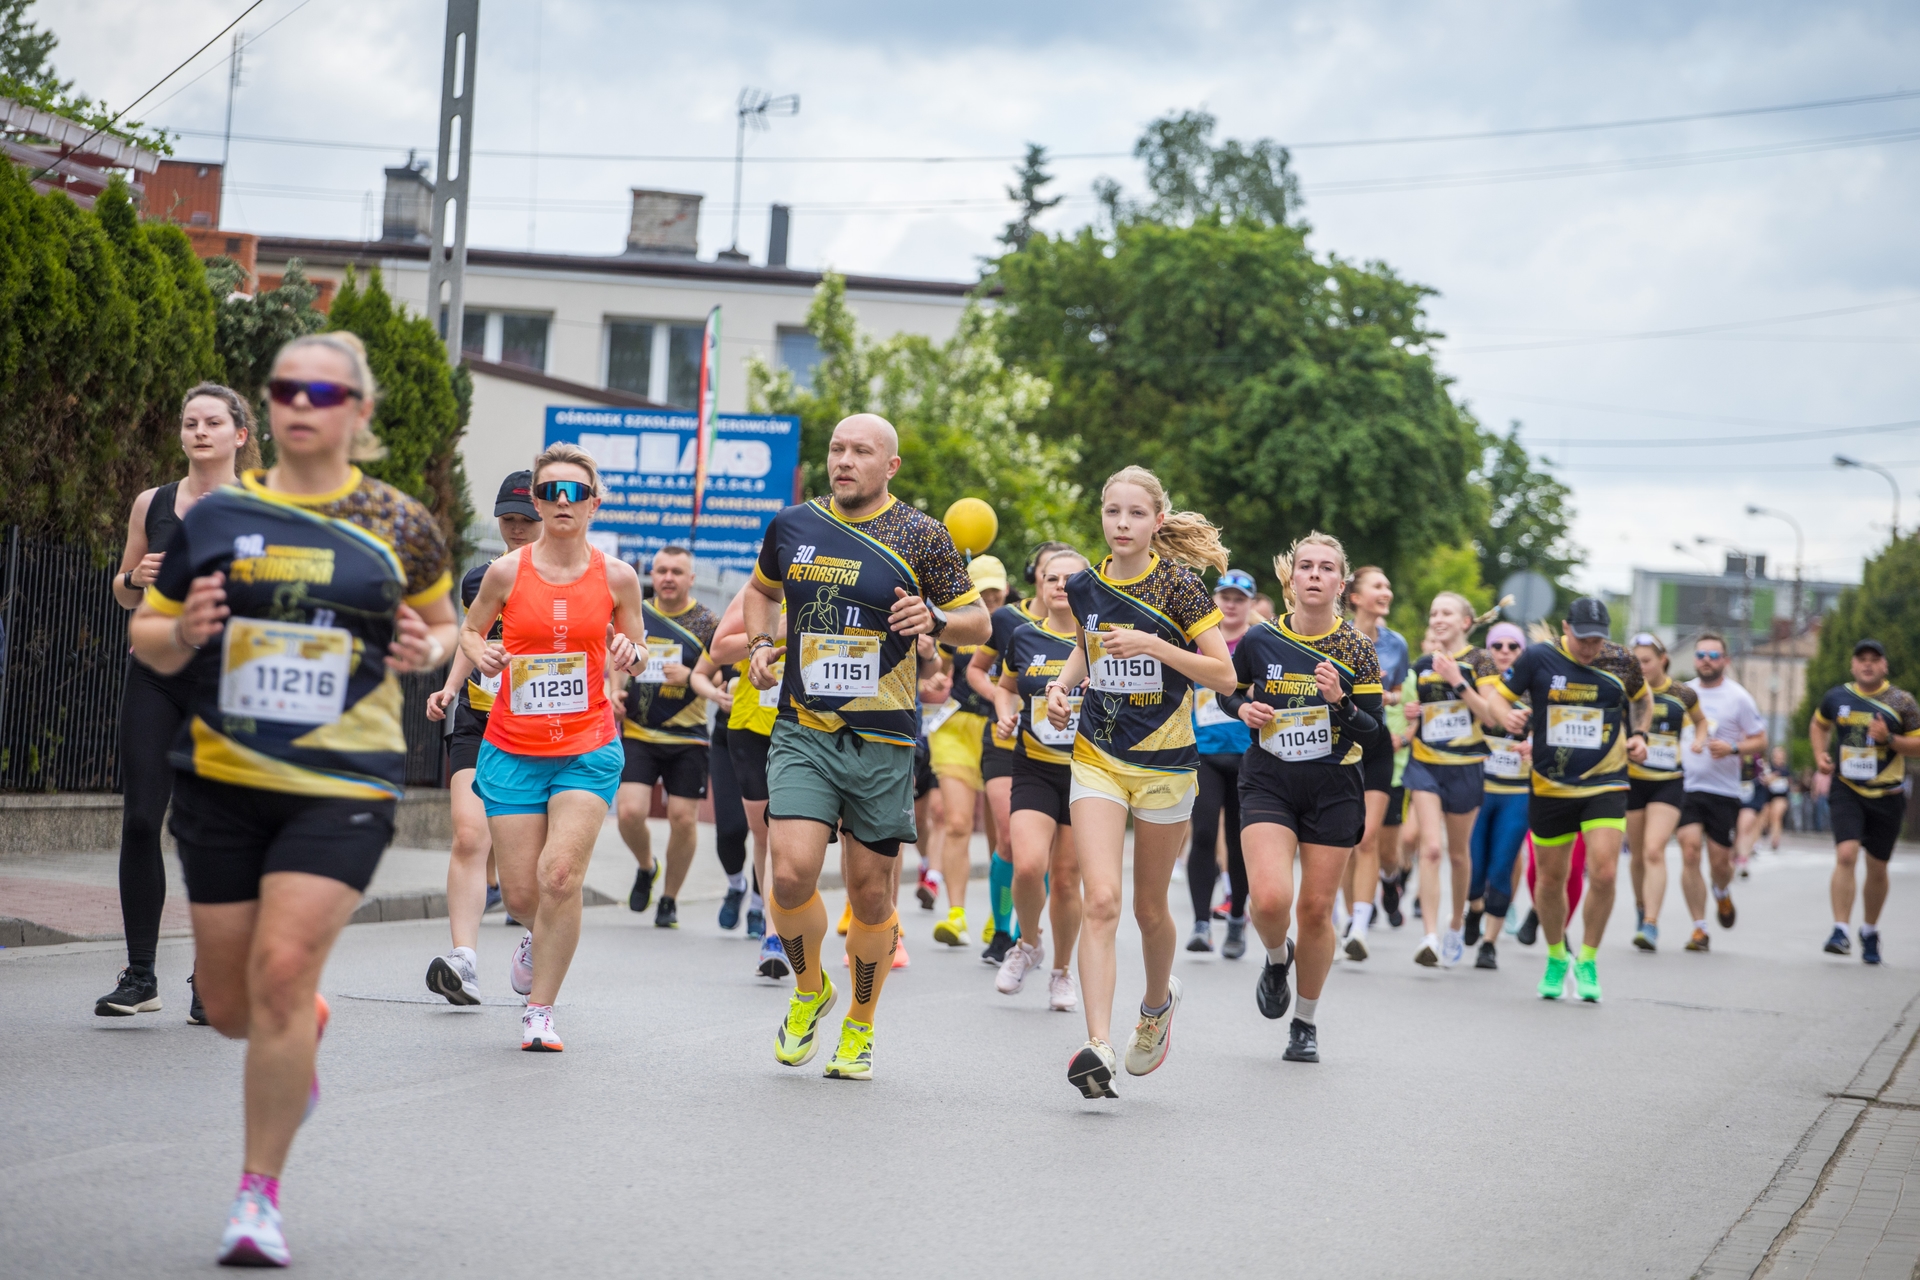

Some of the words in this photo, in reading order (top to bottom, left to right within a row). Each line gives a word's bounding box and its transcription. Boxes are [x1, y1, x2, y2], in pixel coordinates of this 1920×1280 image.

[555, 408, 622, 427] OŚRODEK
[661, 512, 761, 529] ZAWDOWYCH
[793, 545, 815, 564] 30.
[813, 555, 862, 570] MAZOWIECKA
[786, 563, 860, 587] PIĘTNASTKA
[845, 605, 862, 627] 11.
[823, 662, 870, 680] 11151
[1104, 660, 1155, 676] 11150
[1266, 663, 1283, 680] 30.
[255, 664, 336, 697] 11216
[530, 679, 583, 698] 11230
[1279, 729, 1328, 747] 11049
[1565, 724, 1596, 736] 11112
